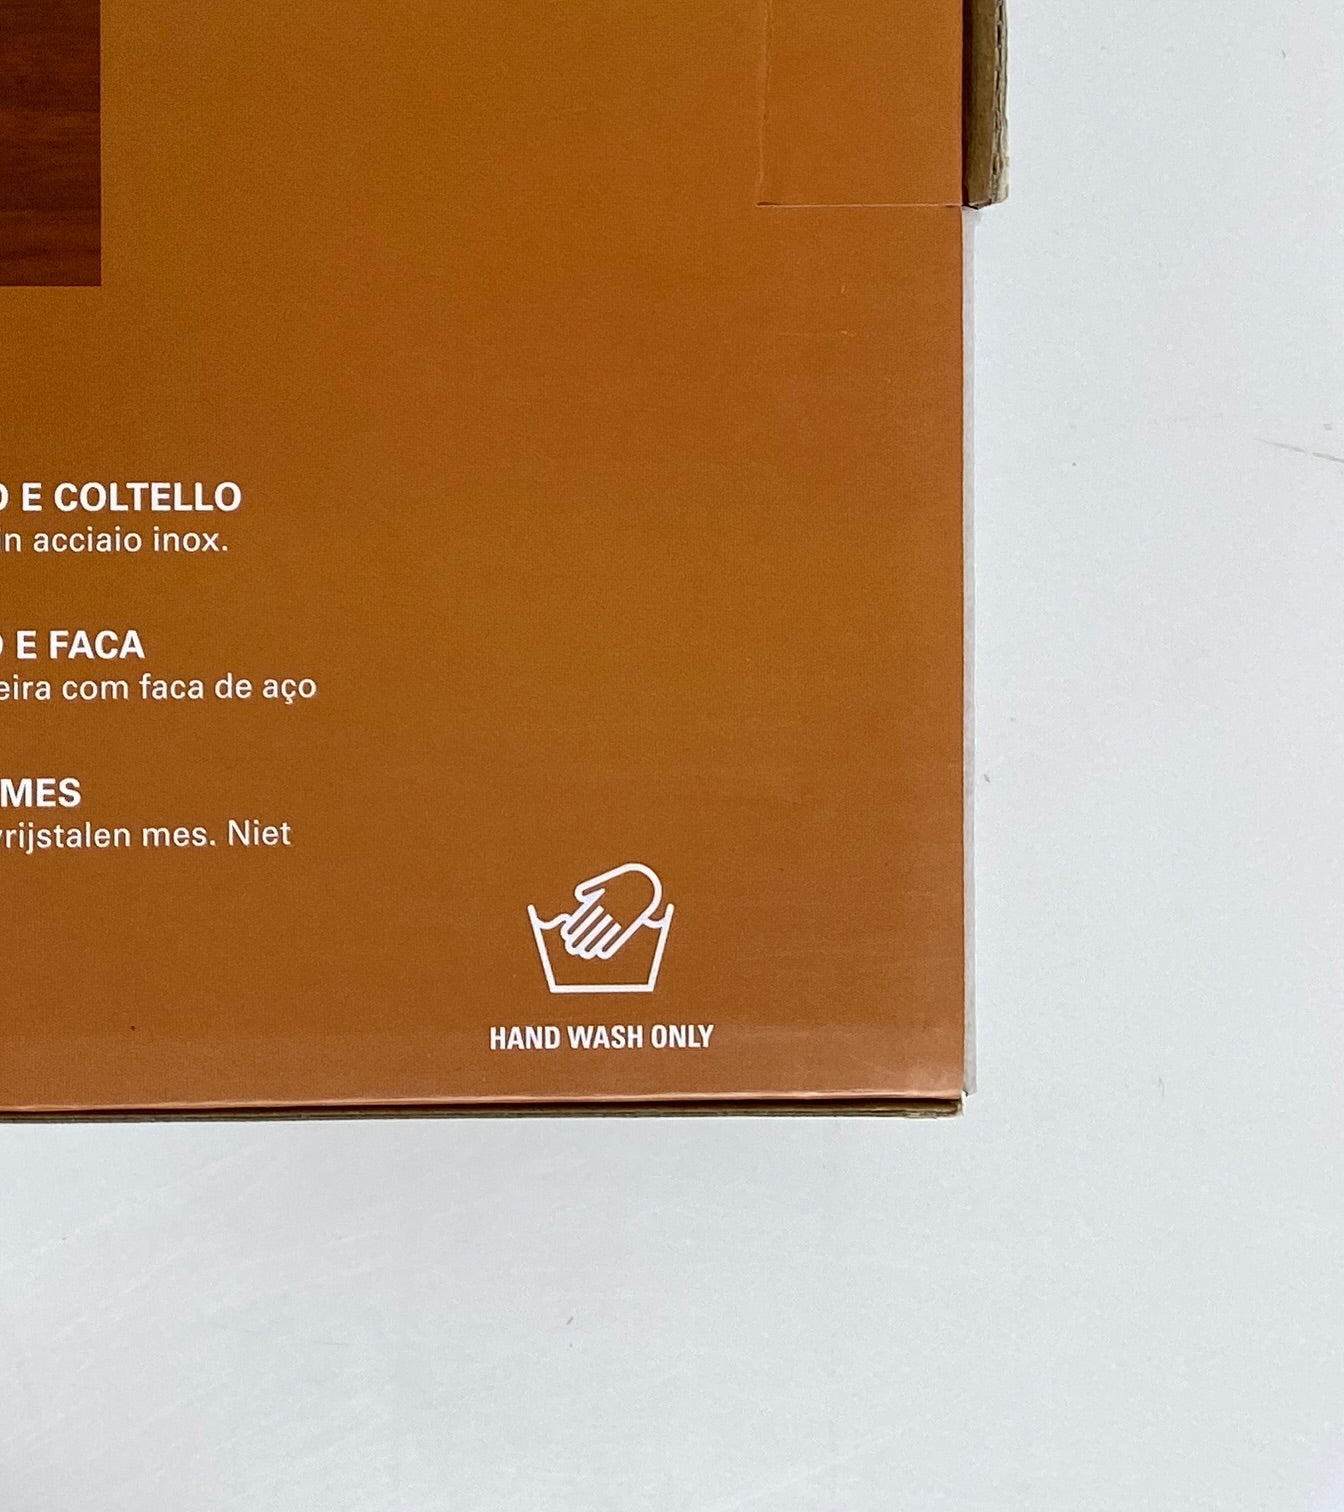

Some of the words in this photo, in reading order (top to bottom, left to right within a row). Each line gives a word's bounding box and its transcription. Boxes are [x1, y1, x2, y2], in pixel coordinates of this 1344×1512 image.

[22, 482, 43, 512] E
[54, 481, 242, 512] COLTELLO
[33, 526, 142, 553] acciaio
[154, 525, 228, 552] inox.
[16, 630, 37, 660] E
[49, 629, 145, 660] FACA
[62, 680, 129, 700] com
[138, 672, 204, 700] faca
[214, 672, 252, 699] de
[262, 678, 317, 705] aço
[0, 777, 82, 808] MES
[142, 827, 216, 847] mes.
[228, 819, 291, 846] Niet
[490, 1025, 561, 1050] HAND
[567, 1024, 644, 1049] WASH
[651, 1024, 714, 1049] ONLY
